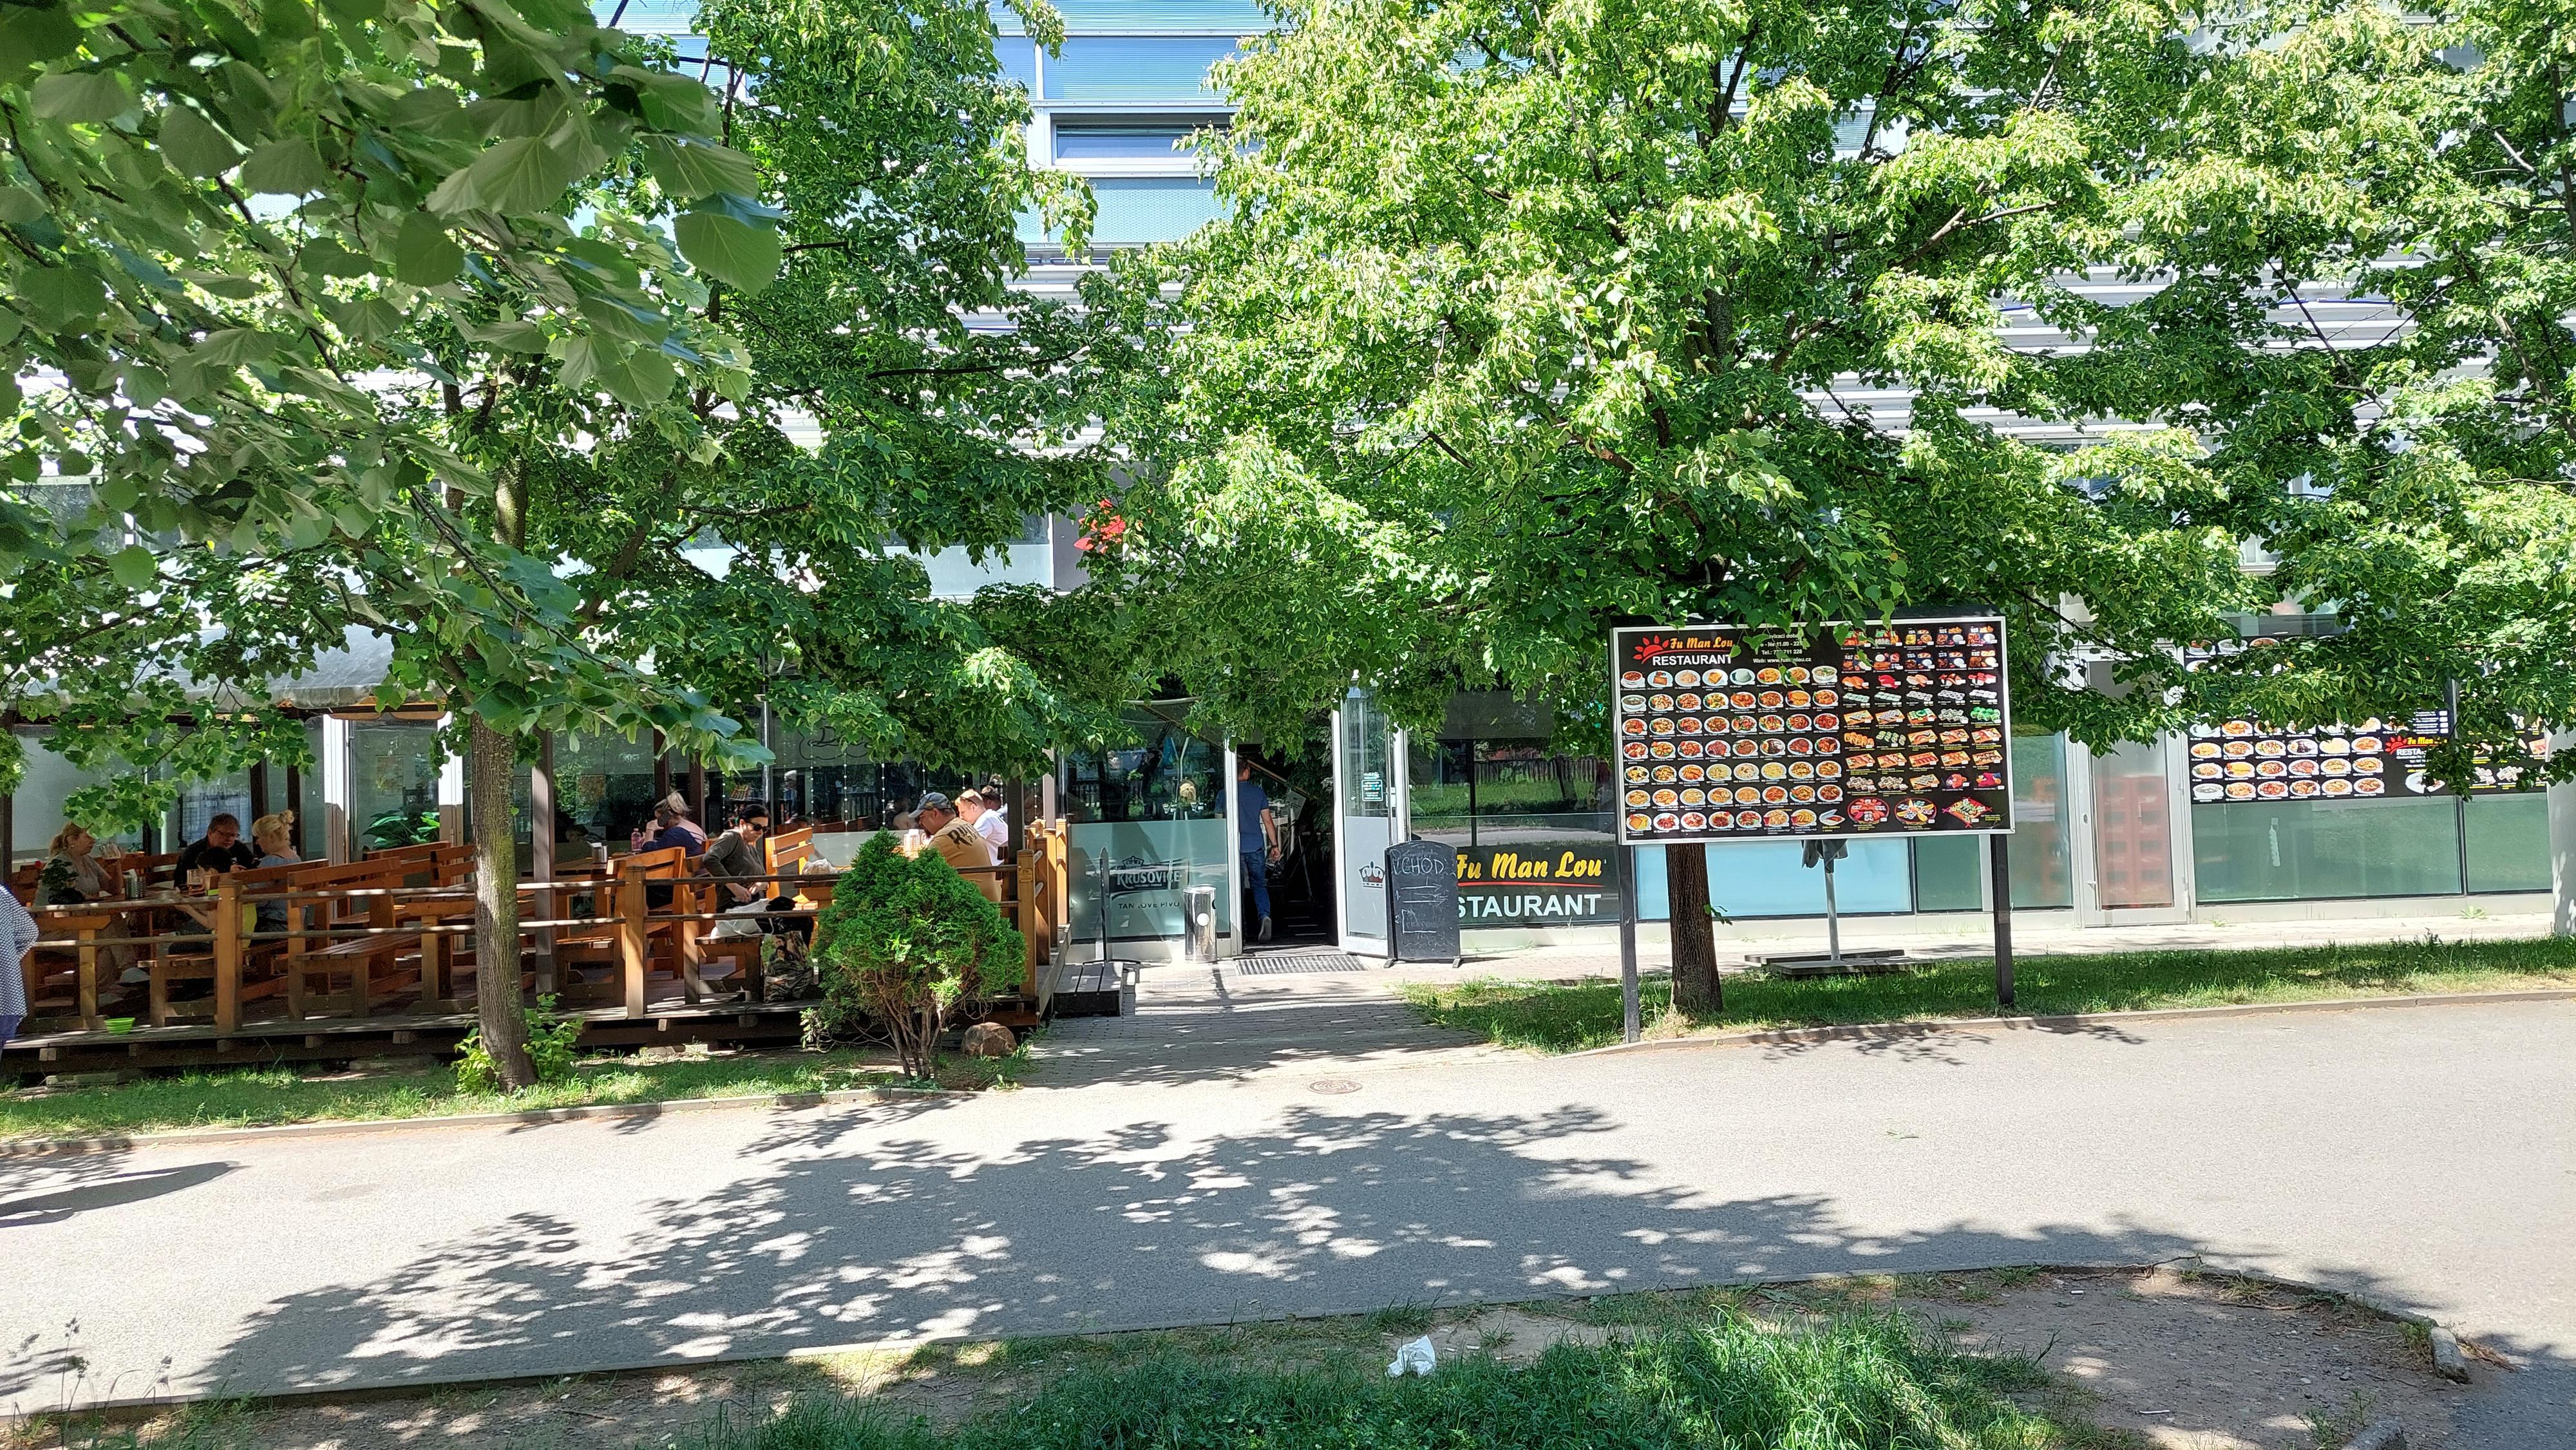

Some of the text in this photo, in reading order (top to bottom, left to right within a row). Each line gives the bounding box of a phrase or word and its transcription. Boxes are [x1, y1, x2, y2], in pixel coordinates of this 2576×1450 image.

[1670, 636, 1734, 649] Fu Man Lou
[1653, 654, 1732, 666] RESTAURANT
[1457, 851, 1602, 880] Fu Man Lou
